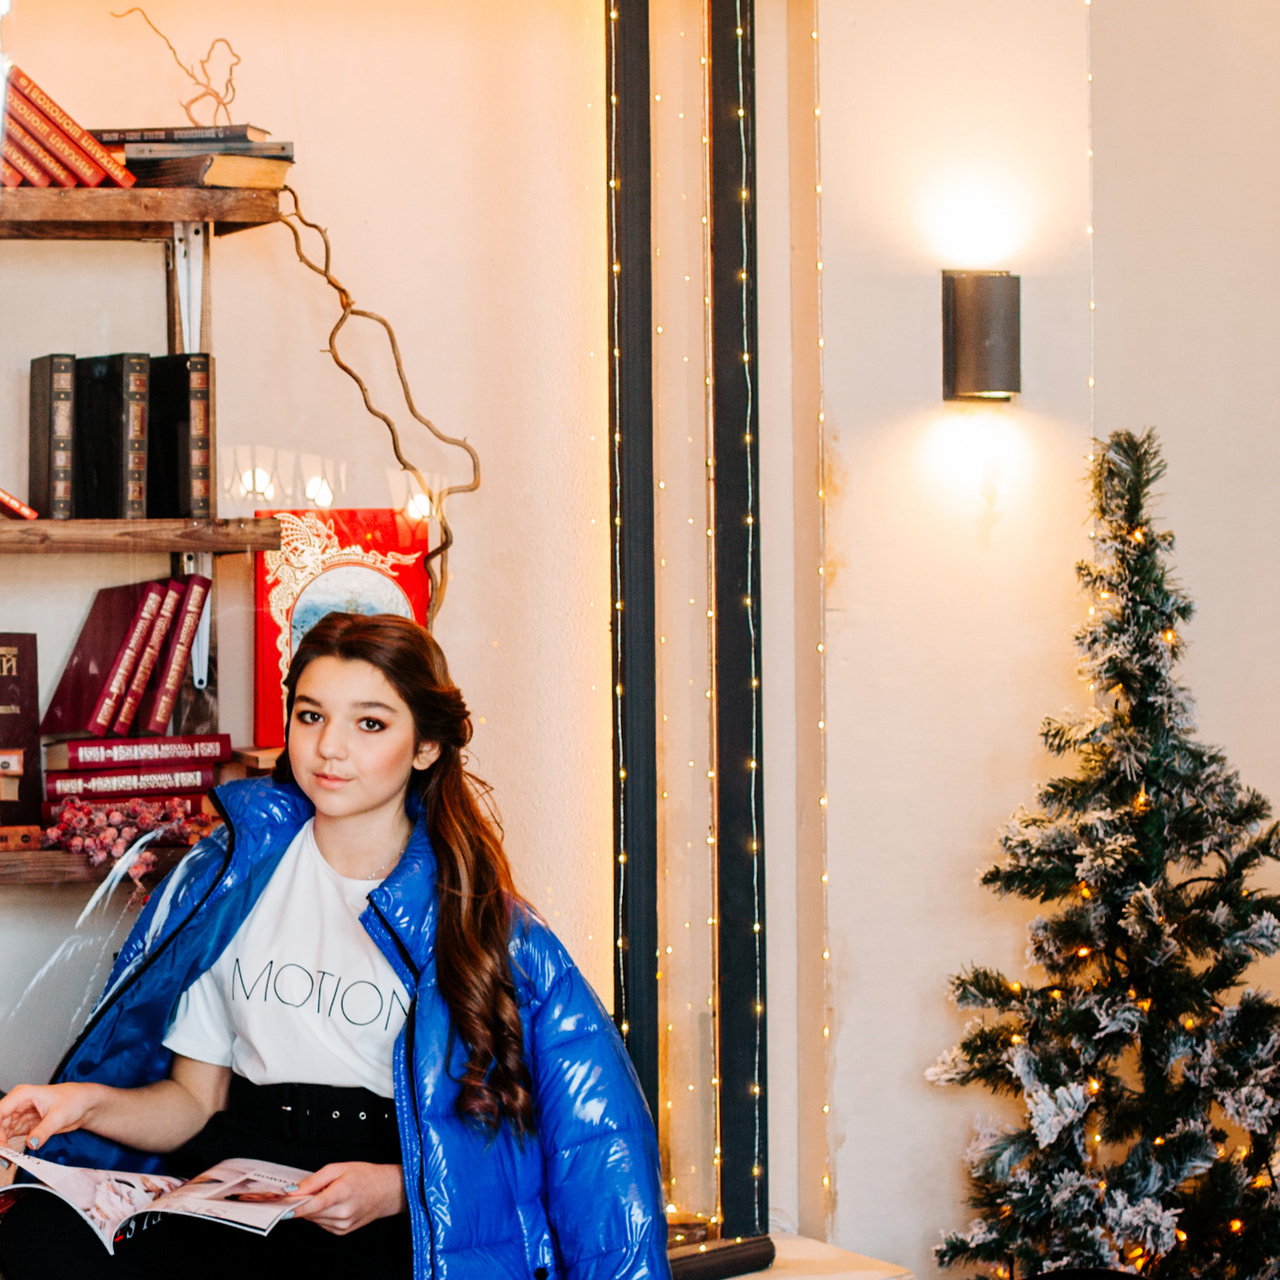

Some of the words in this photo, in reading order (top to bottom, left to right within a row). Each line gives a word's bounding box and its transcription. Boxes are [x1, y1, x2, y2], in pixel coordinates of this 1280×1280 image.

[30, 87, 83, 138] ШОЛОХОВ
[22, 136, 67, 179] МИХАИЛ
[49, 133, 94, 176] МИХАИЛ
[80, 135, 126, 179] МИХАИЛ
